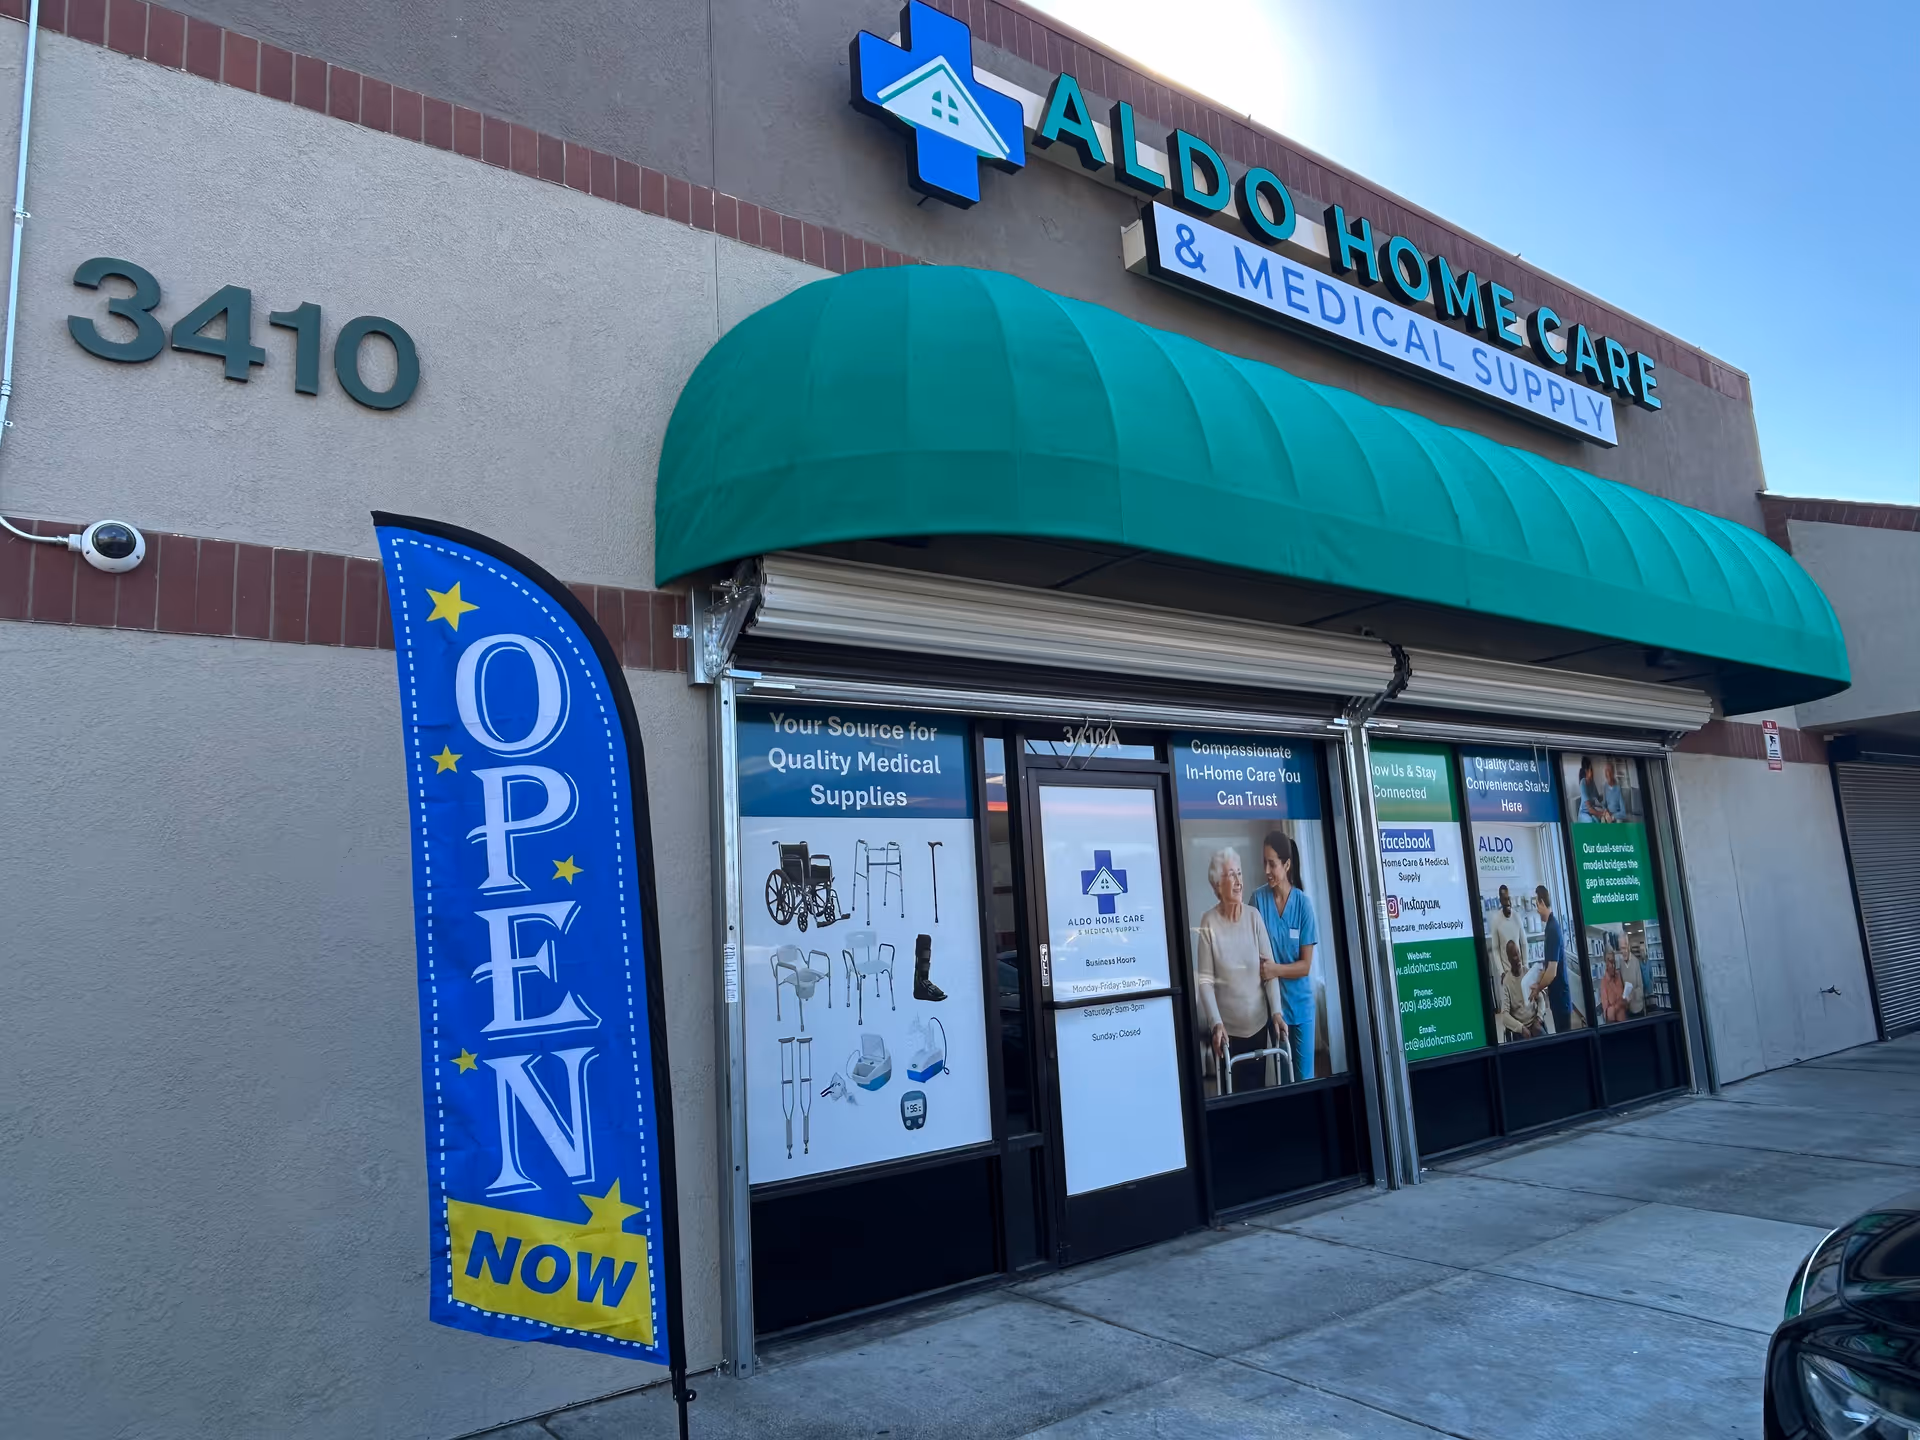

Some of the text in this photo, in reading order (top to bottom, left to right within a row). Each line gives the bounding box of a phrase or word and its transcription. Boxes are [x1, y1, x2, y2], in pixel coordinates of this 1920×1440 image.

[1034, 72, 1663, 411] ALDO HOME CARE
[67, 257, 420, 411] 3410
[1174, 223, 1604, 432] & MEDICAL SUPPLY
[769, 712, 938, 742] Your Source for
[1063, 726, 1121, 749] 3410A
[1191, 739, 1292, 759] Compassionate
[768, 748, 941, 776] Quality Medical
[1475, 757, 1537, 772] Quality Care &
[1186, 764, 1301, 783] In-Home Care You
[1391, 764, 1405, 777] Us
[1406, 765, 1414, 777] &
[1415, 765, 1437, 781] Stay
[1373, 784, 1427, 799] Connected
[1466, 777, 1550, 793] Convenience Starts
[810, 784, 908, 810] Supplies
[1217, 790, 1278, 806] Can Trust
[1501, 799, 1523, 812] Here
[1381, 832, 1431, 850] facebook
[1479, 836, 1513, 853] ALDO
[1582, 842, 1634, 854] Our dual-service
[1402, 857, 1418, 867] Care
[1418, 857, 1424, 867] &
[1424, 857, 1450, 867] Medical
[1583, 858, 1638, 872] model bridges the
[1398, 872, 1421, 883] Supply
[1585, 875, 1641, 890] gap in accessible,
[1592, 891, 1639, 904] affordable care
[1399, 896, 1441, 916] Instagram
[455, 633, 602, 1198] OPEN
[1068, 914, 1145, 927] ALDO HOME CARE
[1084, 927, 1113, 935] MEDICAL
[1115, 926, 1140, 934] SUPPLY
[1085, 956, 1136, 967] Business Hours
[1072, 978, 1152, 994] Monday-Friday: 9am-7pm
[1083, 1002, 1145, 1018] Saturday: 9am-3pm
[1417, 996, 1452, 1010] 488-8600
[1118, 1027, 1142, 1039] Closed
[463, 1229, 638, 1309] NOW
